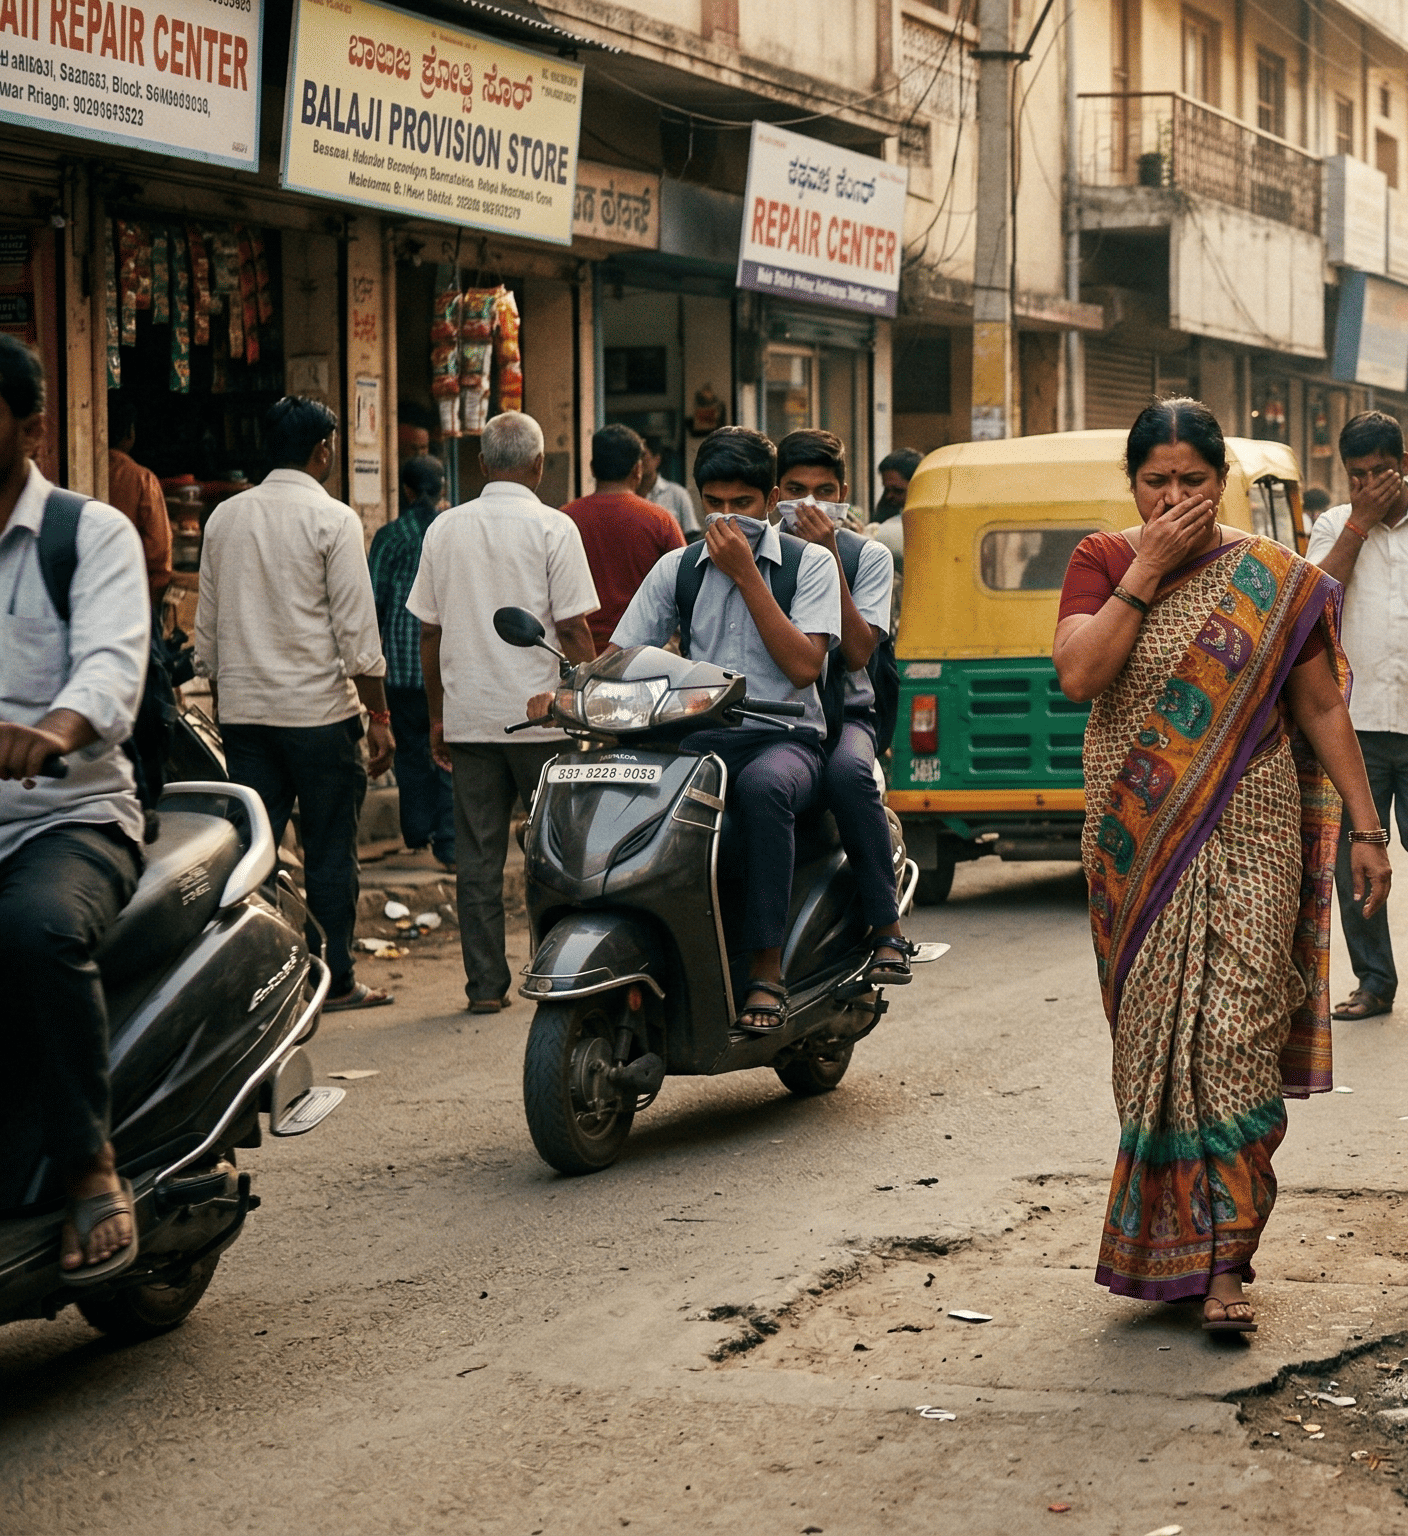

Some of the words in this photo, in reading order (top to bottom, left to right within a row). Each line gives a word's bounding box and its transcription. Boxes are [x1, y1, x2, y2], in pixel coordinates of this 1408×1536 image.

[50, 0, 145, 67] REPAIR
[153, 14, 248, 91] CENTER
[301, 79, 382, 142] BALAJI
[389, 102, 501, 170] PROVISION
[507, 133, 569, 185] STORE
[751, 197, 822, 258] REPAIR
[826, 216, 898, 276] CENTER
